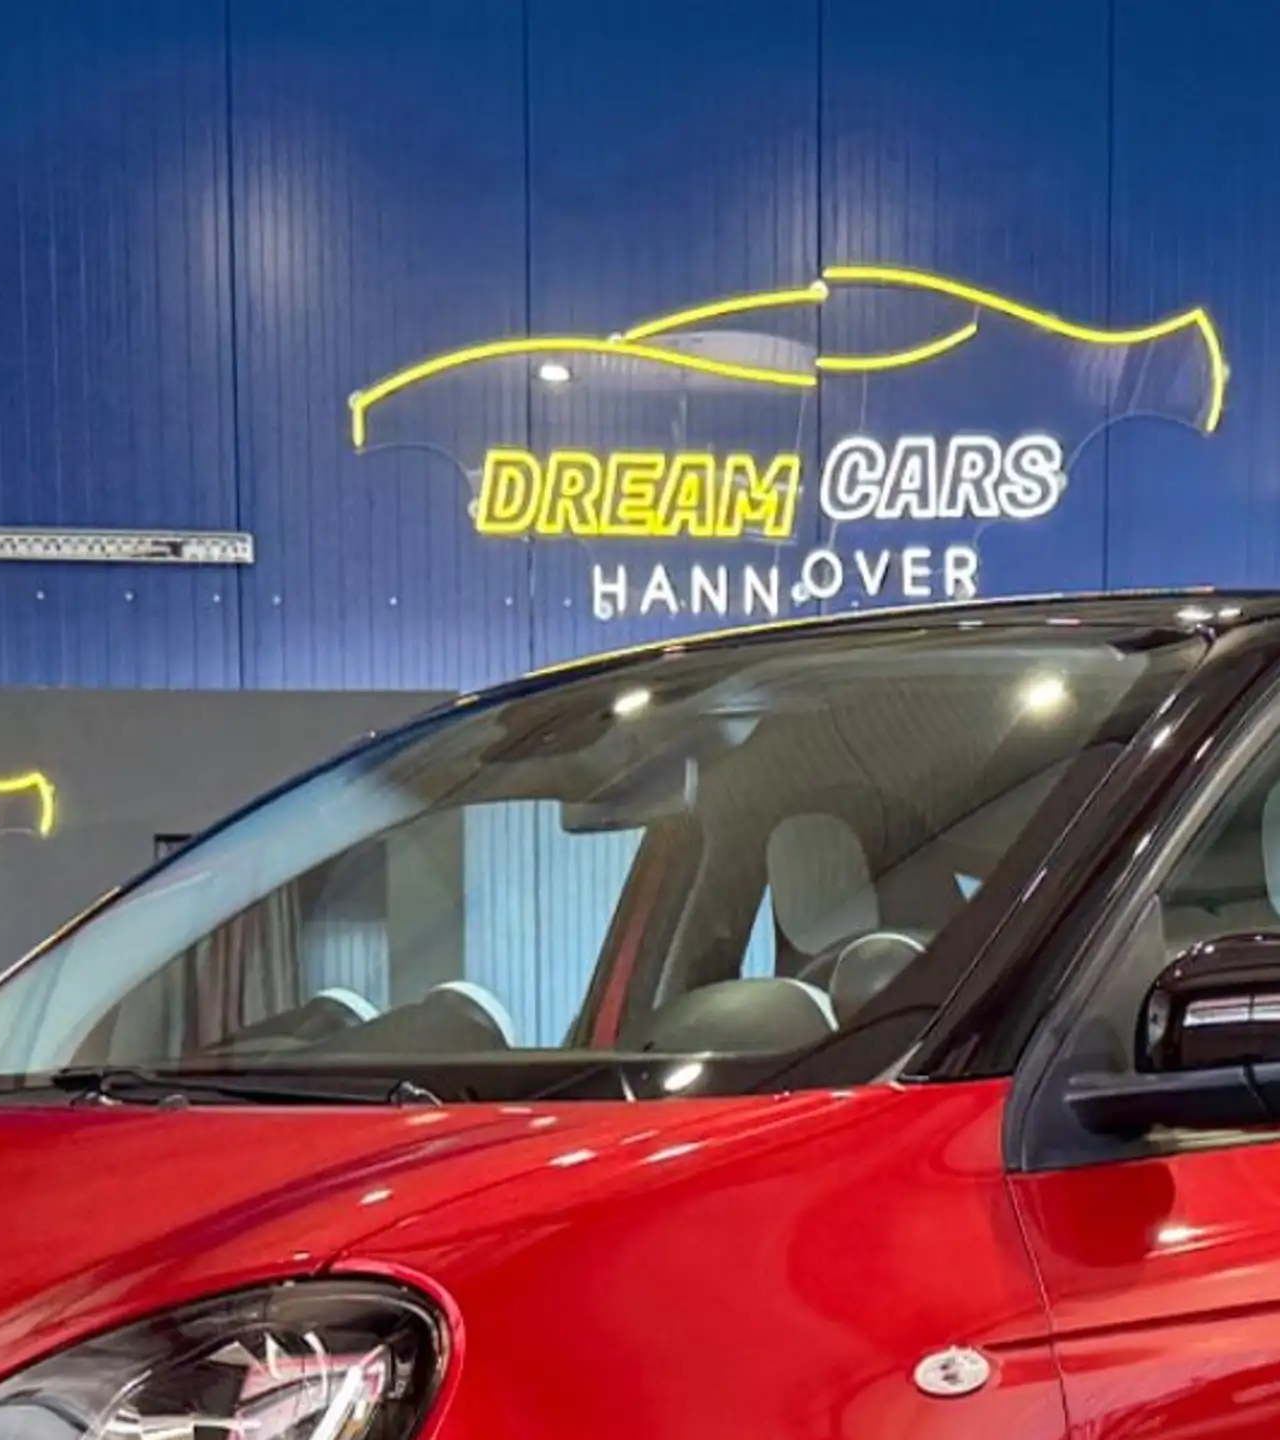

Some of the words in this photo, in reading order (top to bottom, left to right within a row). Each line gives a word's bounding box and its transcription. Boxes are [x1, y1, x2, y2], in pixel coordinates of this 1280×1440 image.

[476, 450, 800, 537] DREAM
[821, 434, 1066, 519] CARS
[592, 547, 979, 616] HANNOVER
